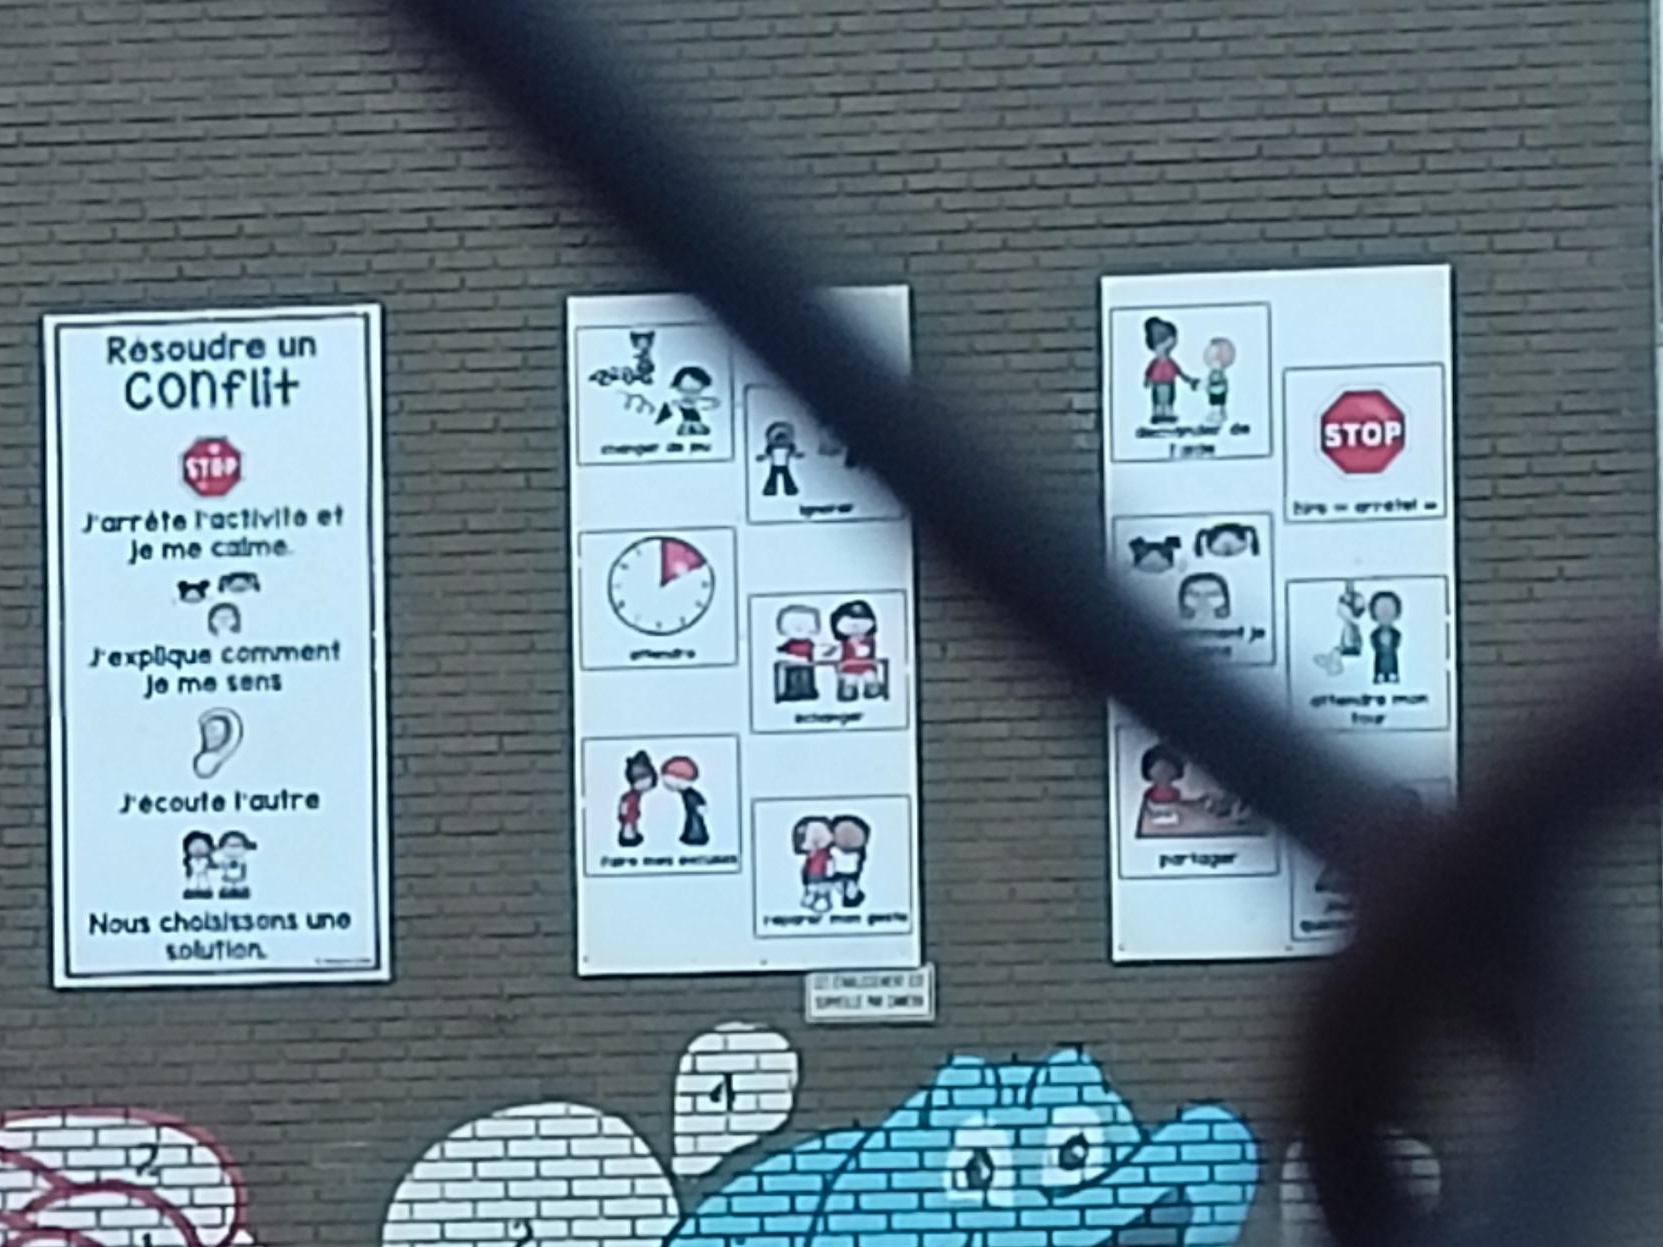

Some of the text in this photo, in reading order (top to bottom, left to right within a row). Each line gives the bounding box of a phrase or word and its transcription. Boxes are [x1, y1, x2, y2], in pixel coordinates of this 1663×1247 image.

[106, 332, 317, 364] Résoudre un
[1324, 421, 1402, 449] STOP
[186, 457, 238, 480] STOP
[317, 504, 344, 526] et
[161, 540, 203, 560] me
[220, 639, 342, 662] comment
[176, 674, 218, 694] me
[234, 788, 321, 811] l'autre
[89, 909, 352, 936] Nous choisissons une
[710, 1073, 735, 1113] 4
